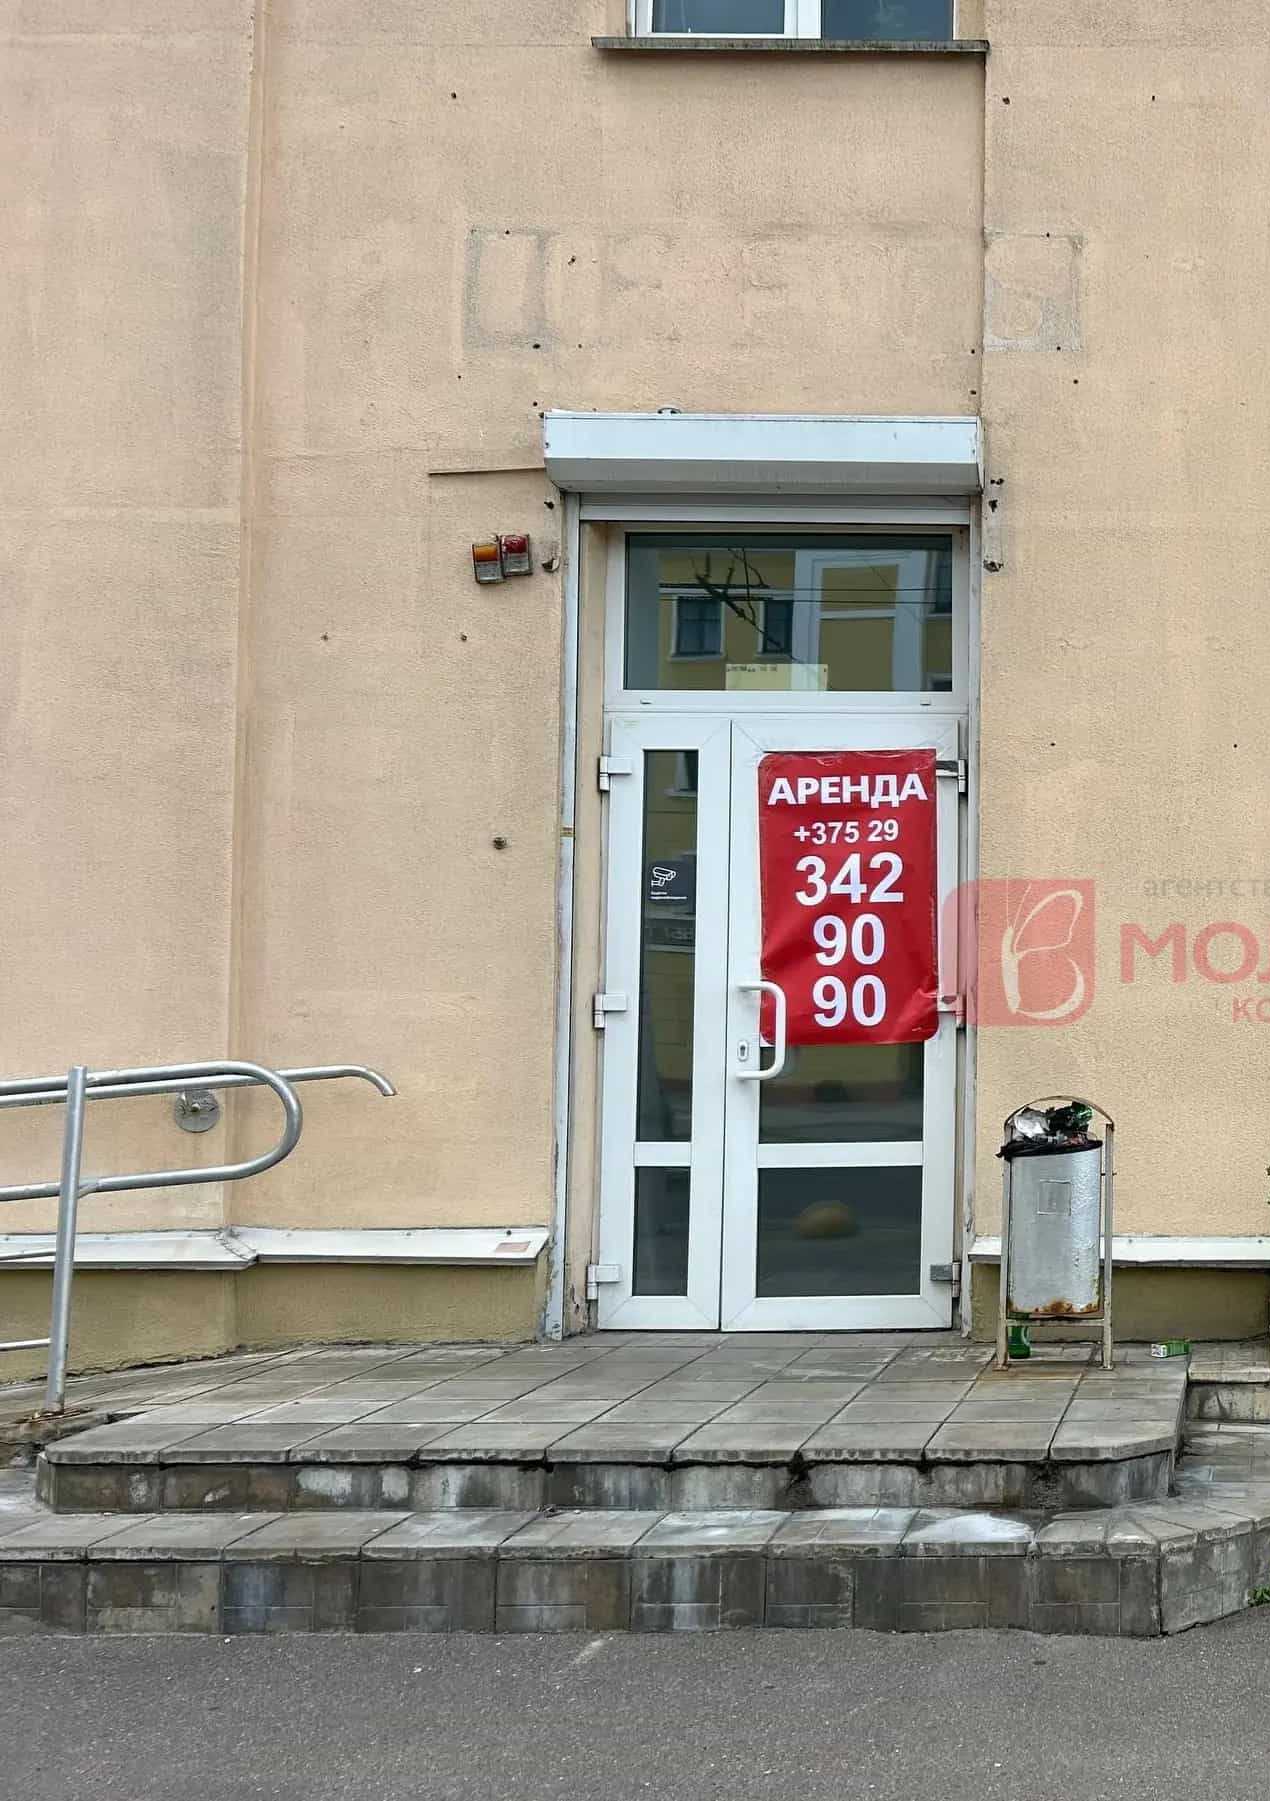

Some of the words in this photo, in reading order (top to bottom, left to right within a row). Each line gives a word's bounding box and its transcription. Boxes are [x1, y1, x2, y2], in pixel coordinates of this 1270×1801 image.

[767, 773, 928, 809] АРЕНДА
[794, 821, 860, 845] +375
[867, 819, 899, 842] 29
[795, 852, 904, 906] 342
[813, 913, 886, 967] 90
[812, 974, 887, 1027] 90
